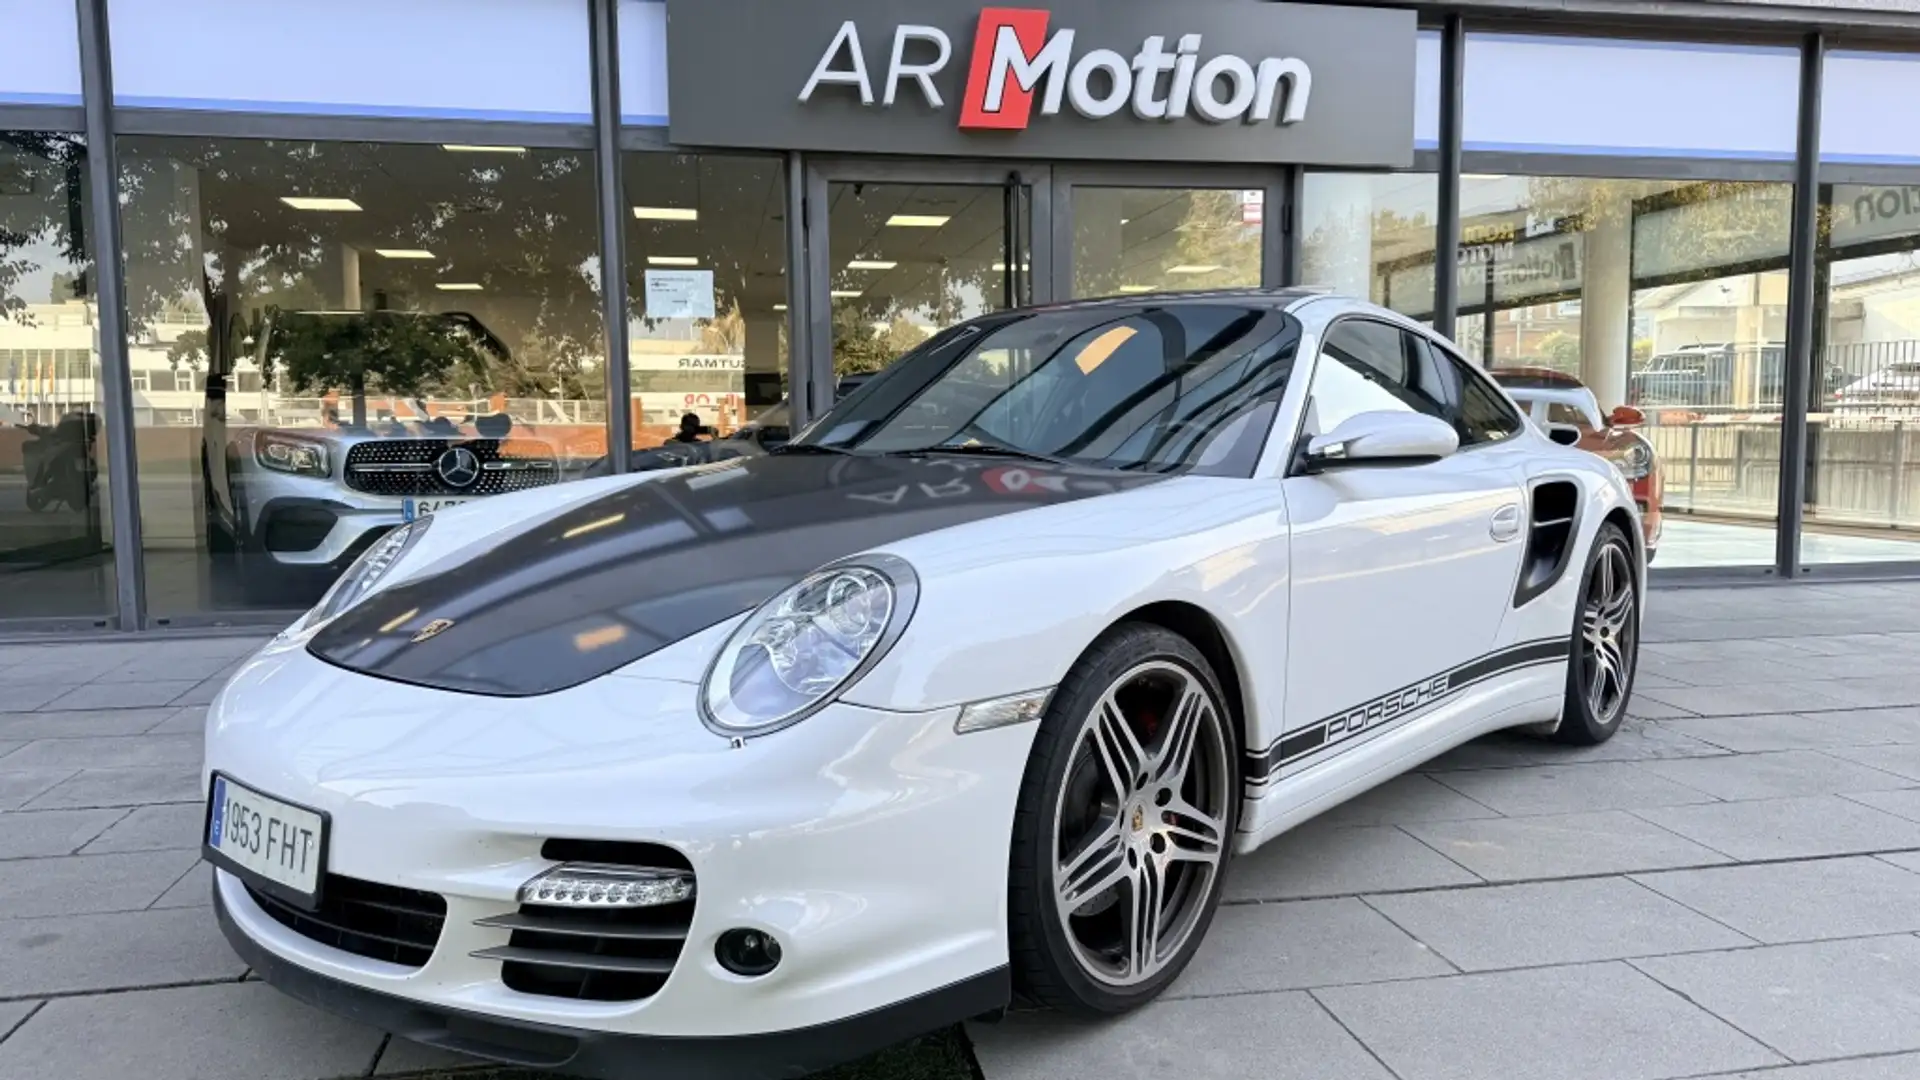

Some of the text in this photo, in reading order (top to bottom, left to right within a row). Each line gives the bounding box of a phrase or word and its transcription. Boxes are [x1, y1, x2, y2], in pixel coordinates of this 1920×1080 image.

[797, 20, 1313, 124] AR Motion
[1326, 674, 1448, 742] PORSCHE
[224, 797, 313, 873] 1953 FHT
